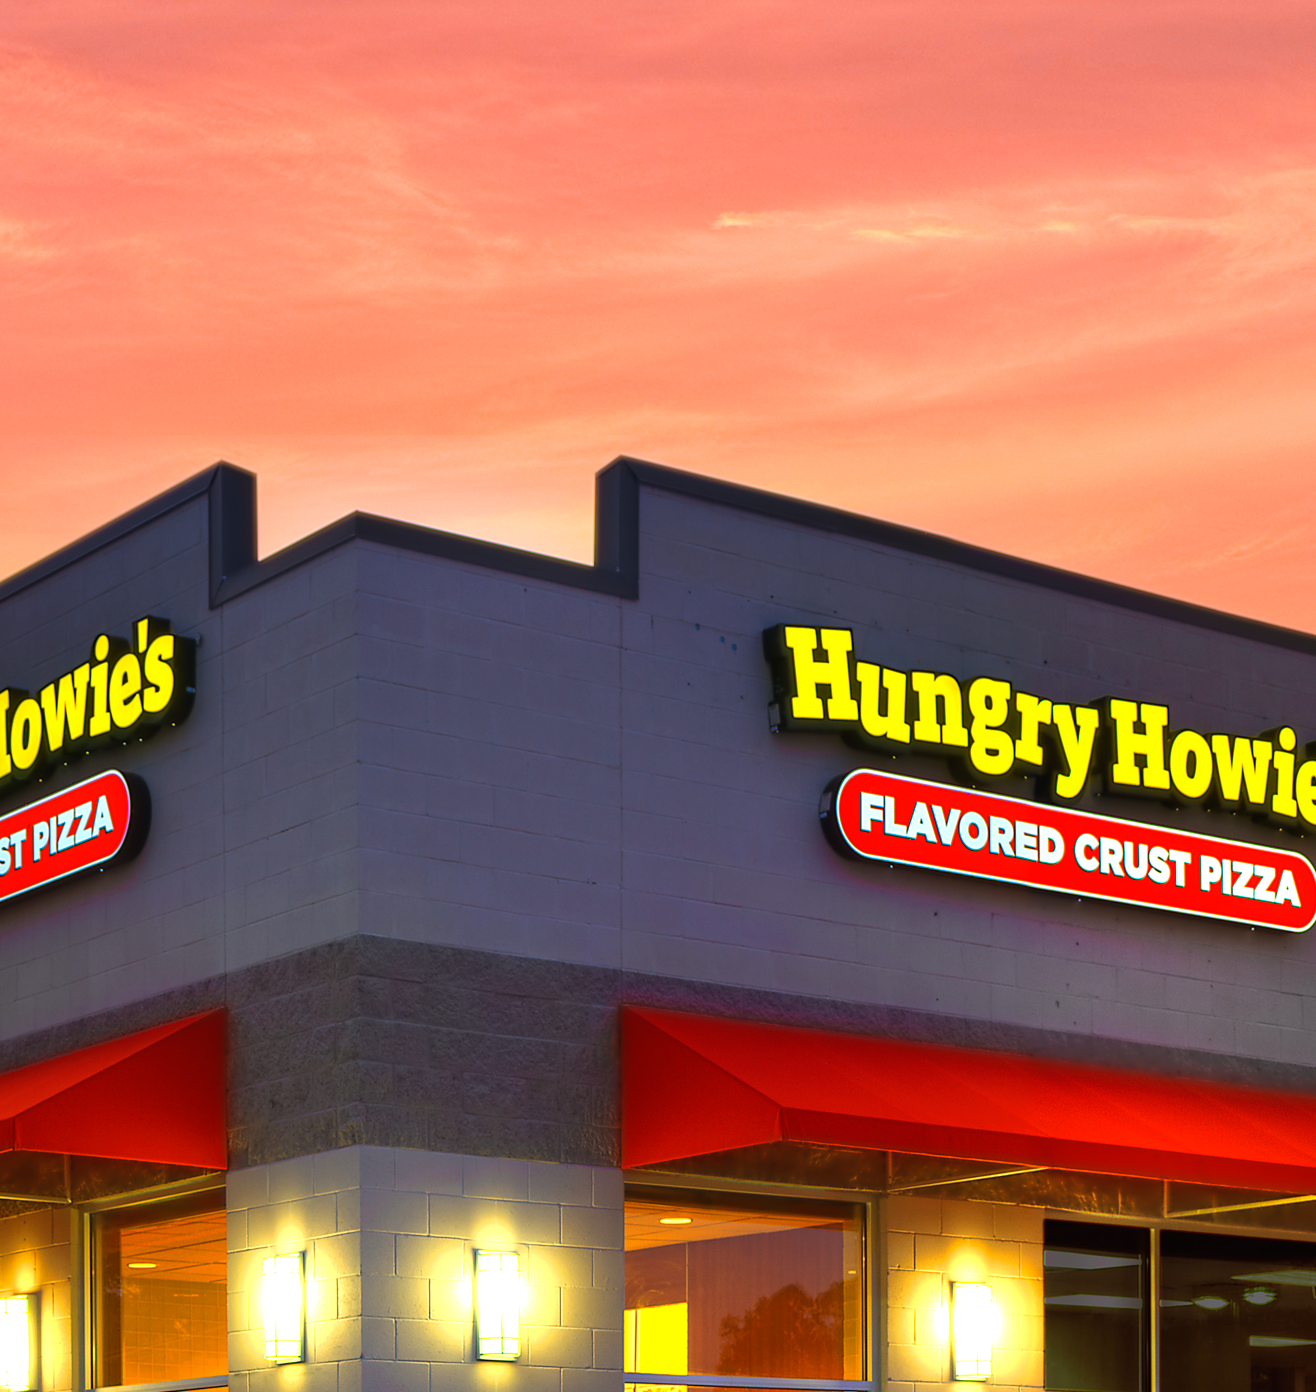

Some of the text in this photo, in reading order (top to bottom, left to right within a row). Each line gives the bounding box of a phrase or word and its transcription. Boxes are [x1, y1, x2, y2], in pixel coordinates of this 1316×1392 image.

[785, 626, 1099, 798] Hungry
[32, 795, 114, 861] PIZZA
[860, 791, 1301, 908] FLAVORED CRUST PIZZA
